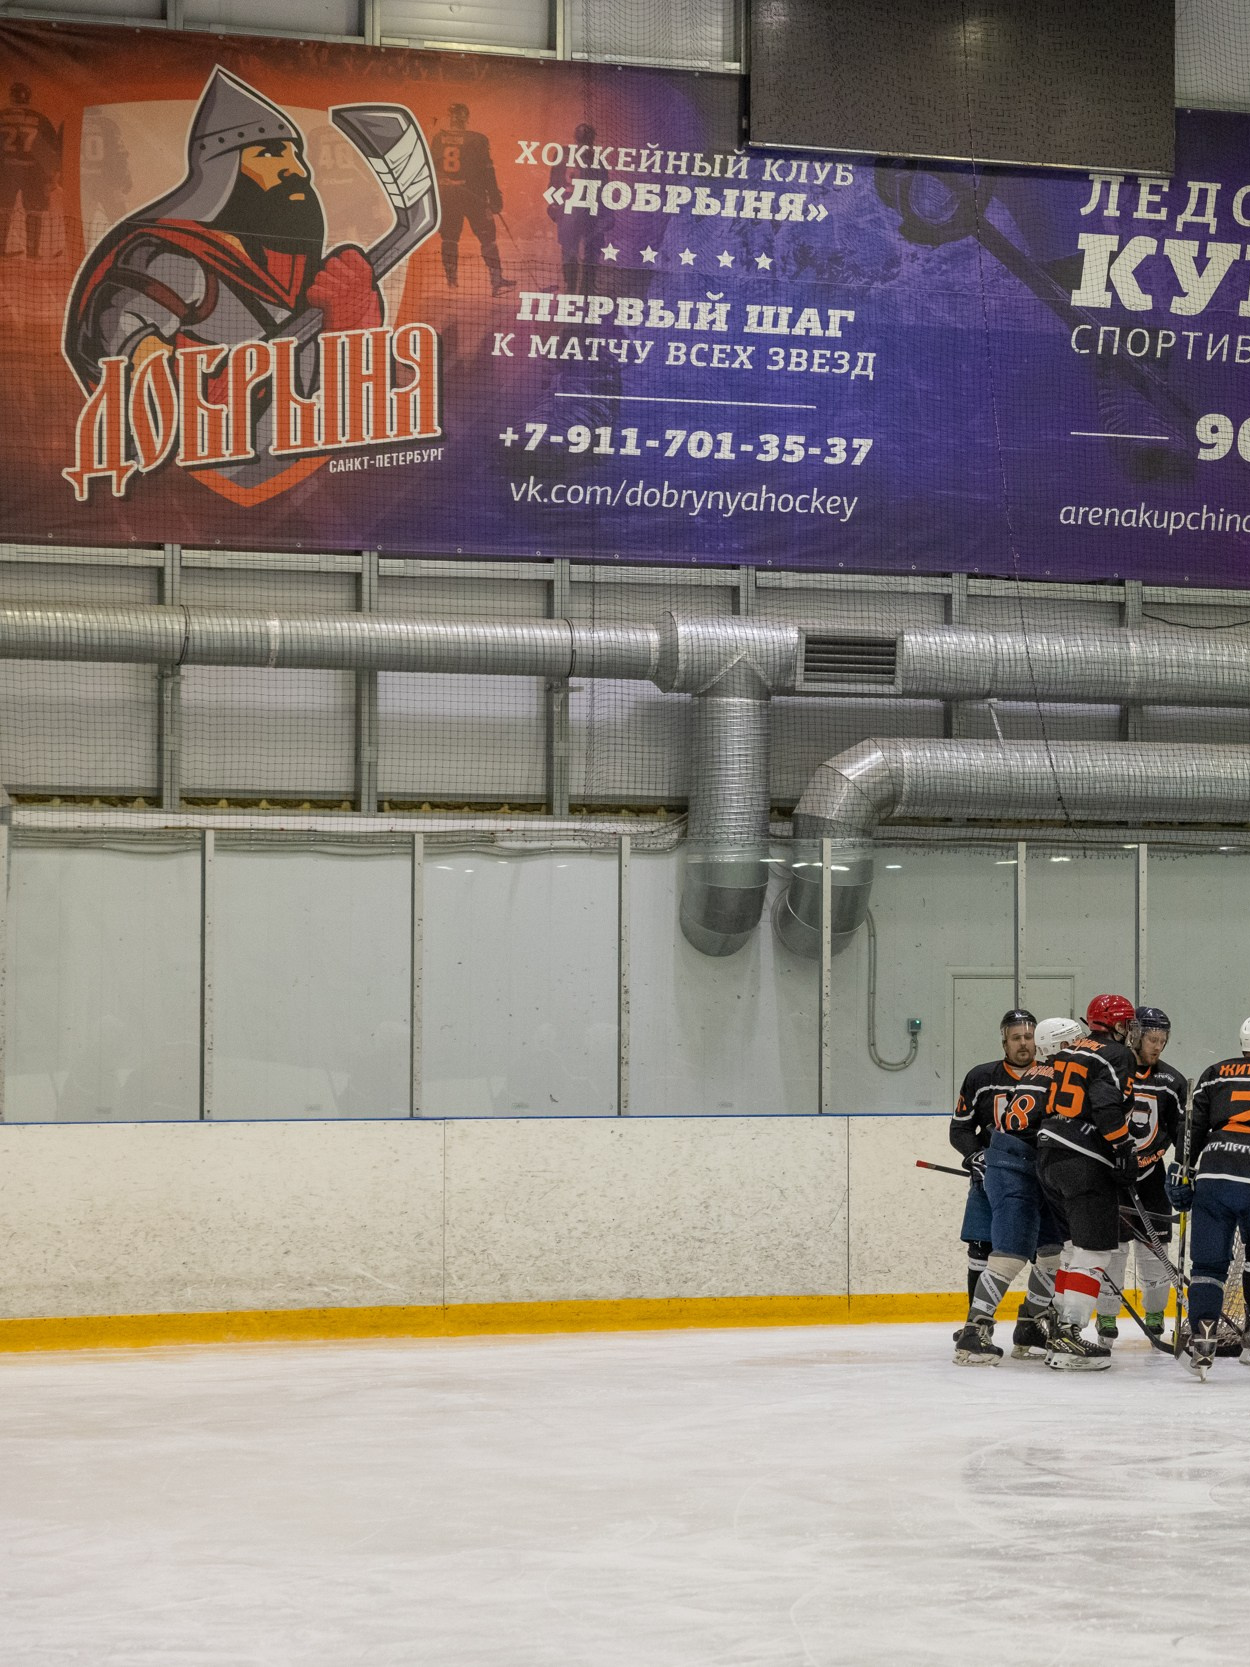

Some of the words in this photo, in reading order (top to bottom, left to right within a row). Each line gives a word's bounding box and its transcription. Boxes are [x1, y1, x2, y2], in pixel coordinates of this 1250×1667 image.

[443, 146, 461, 172] 8
[515, 140, 750, 180] ХОККЕЙНЫЙ
[762, 158, 855, 187] КЛУБ
[542, 178, 829, 222] «ДОБРЫНЯ»
[516, 291, 731, 332] ПЕРВЫЙ
[743, 304, 856, 338] ШАГ
[492, 333, 515, 358] К
[527, 334, 654, 365] МАТЧУ
[664, 341, 757, 370] ВСЕХ
[766, 347, 877, 380] ЗВЕЗД
[61, 322, 442, 501] ДОБРЫНЯ
[328, 447, 445, 474] САНКТ-ПЕТЕРБУРГ
[498, 422, 874, 467] +7-911-701-35-37
[510, 475, 859, 523] vk.com/dobrynyahockey
